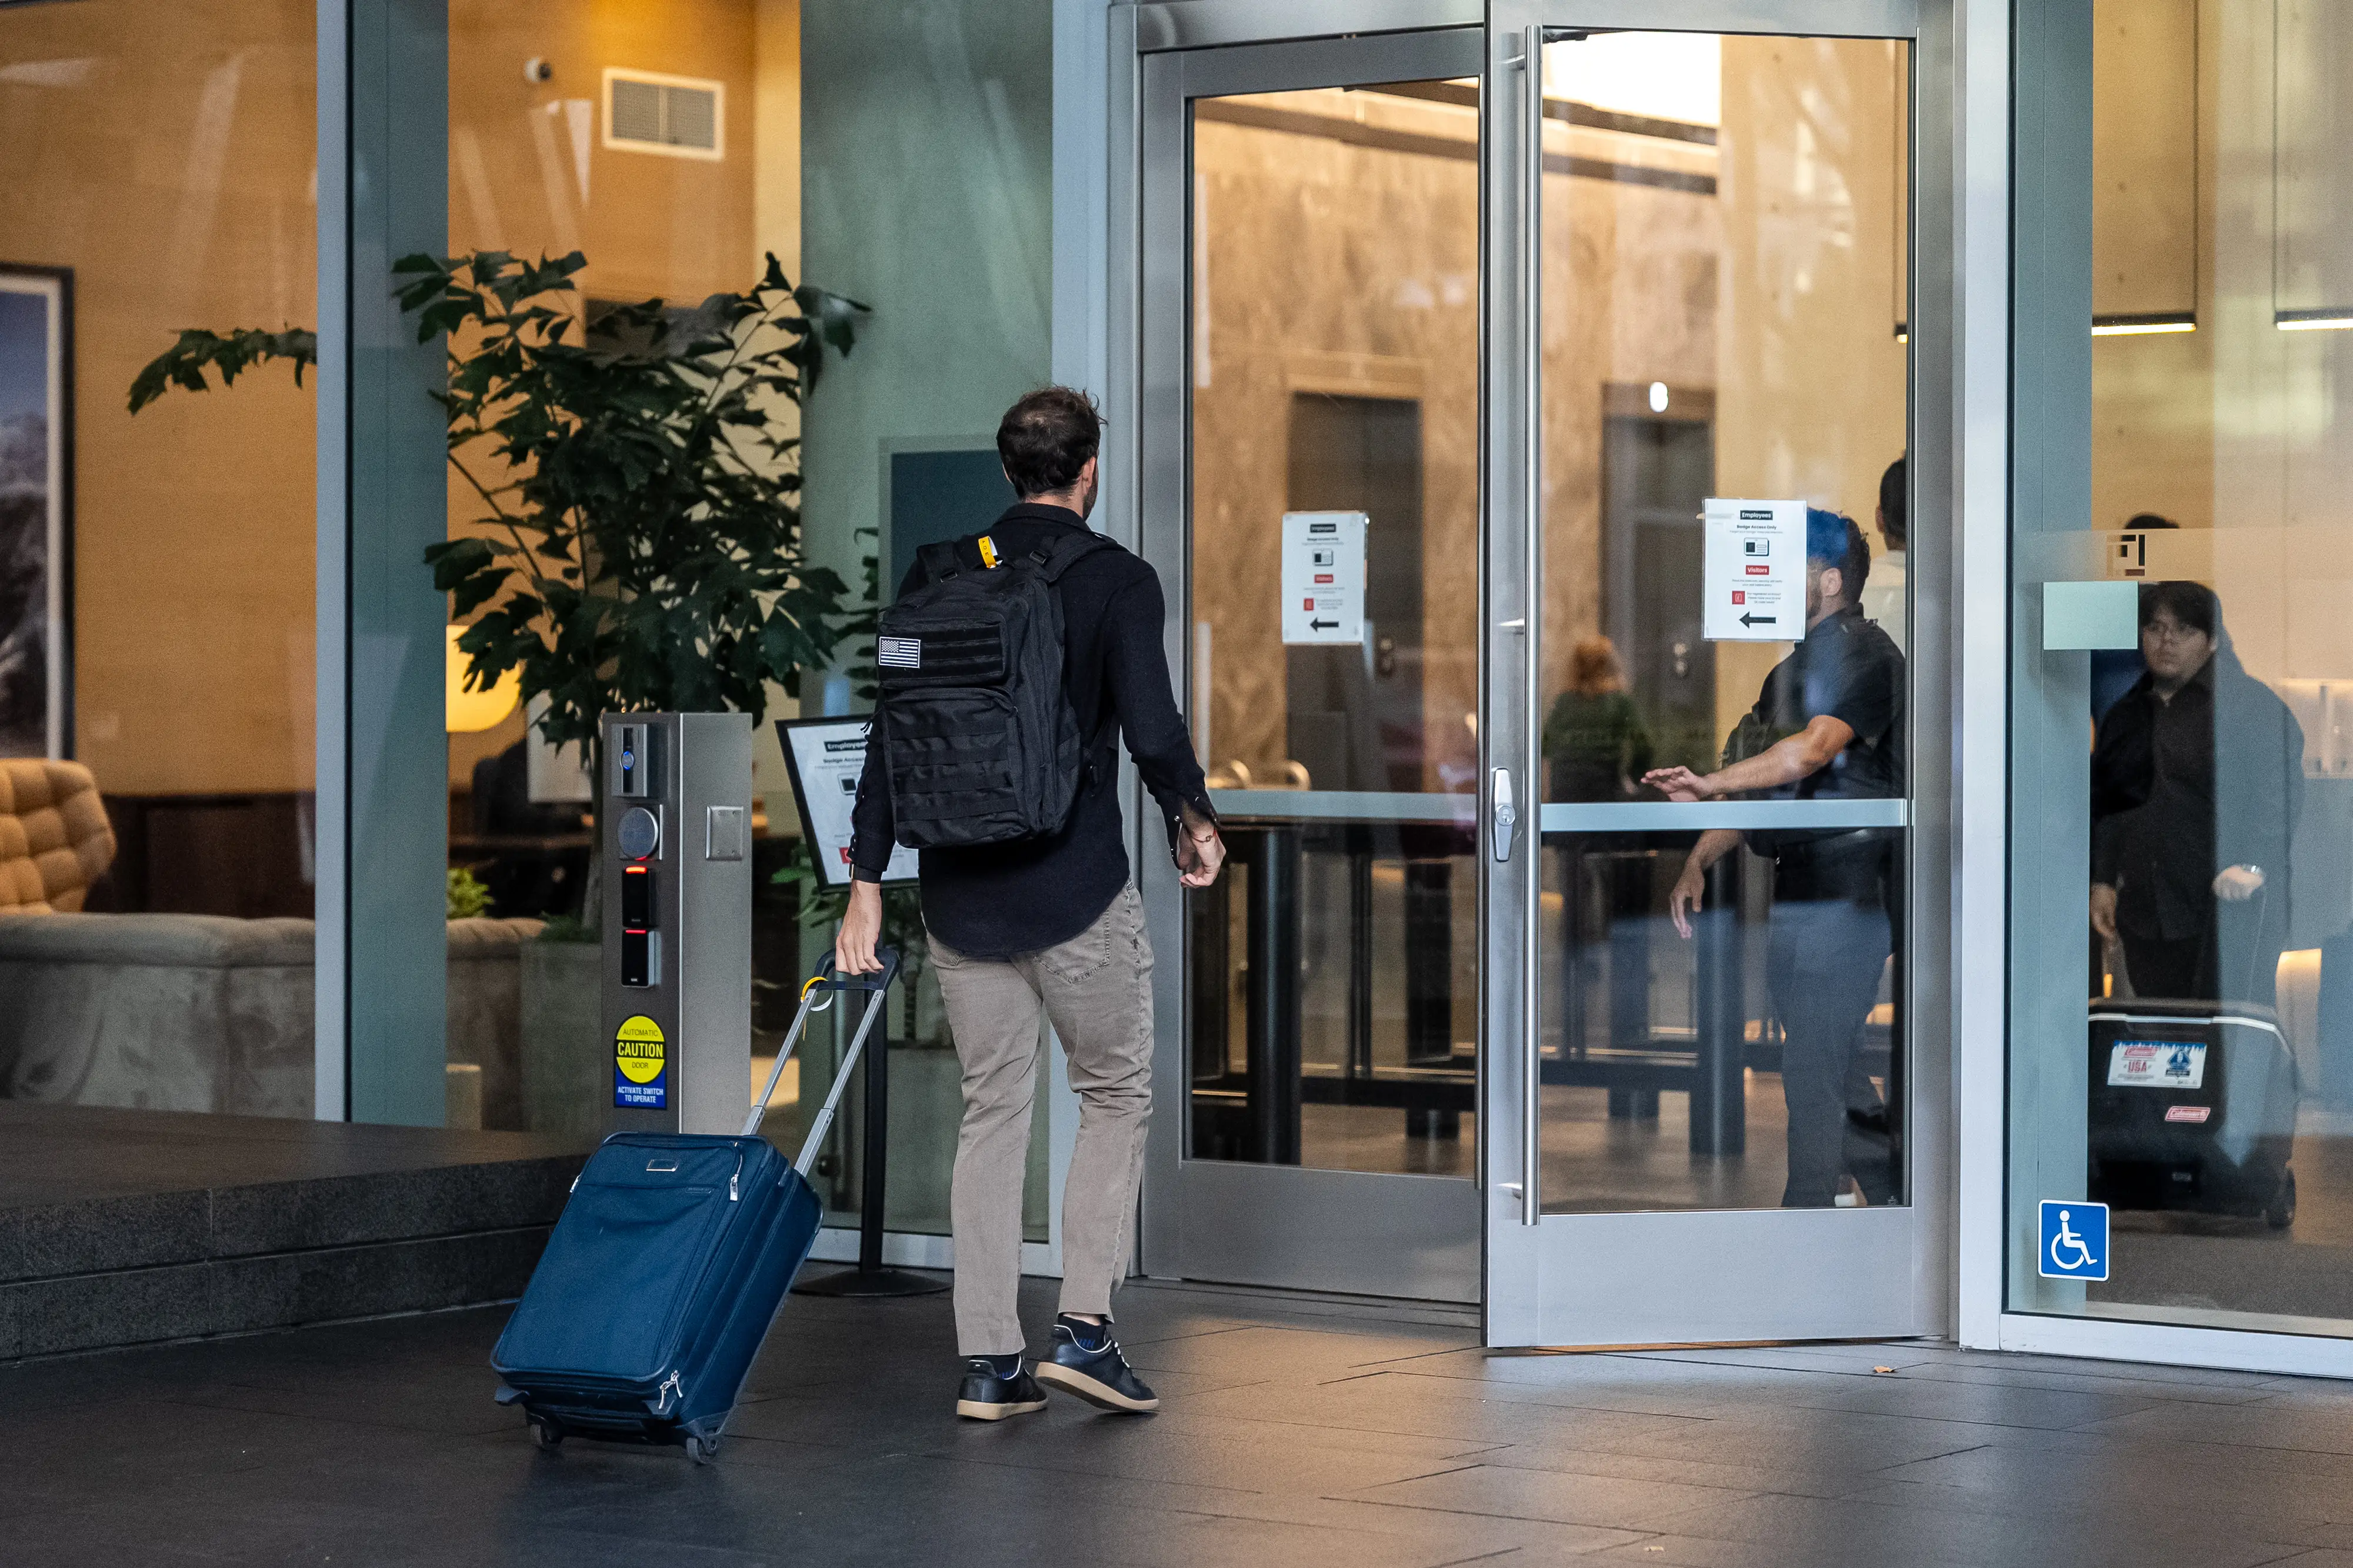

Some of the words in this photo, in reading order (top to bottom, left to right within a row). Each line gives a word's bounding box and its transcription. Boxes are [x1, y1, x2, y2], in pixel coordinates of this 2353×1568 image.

[622, 1029, 658, 1037] AUTOMATIC
[618, 1042, 663, 1057] CAUTION
[643, 1087, 664, 1096] SWITCH
